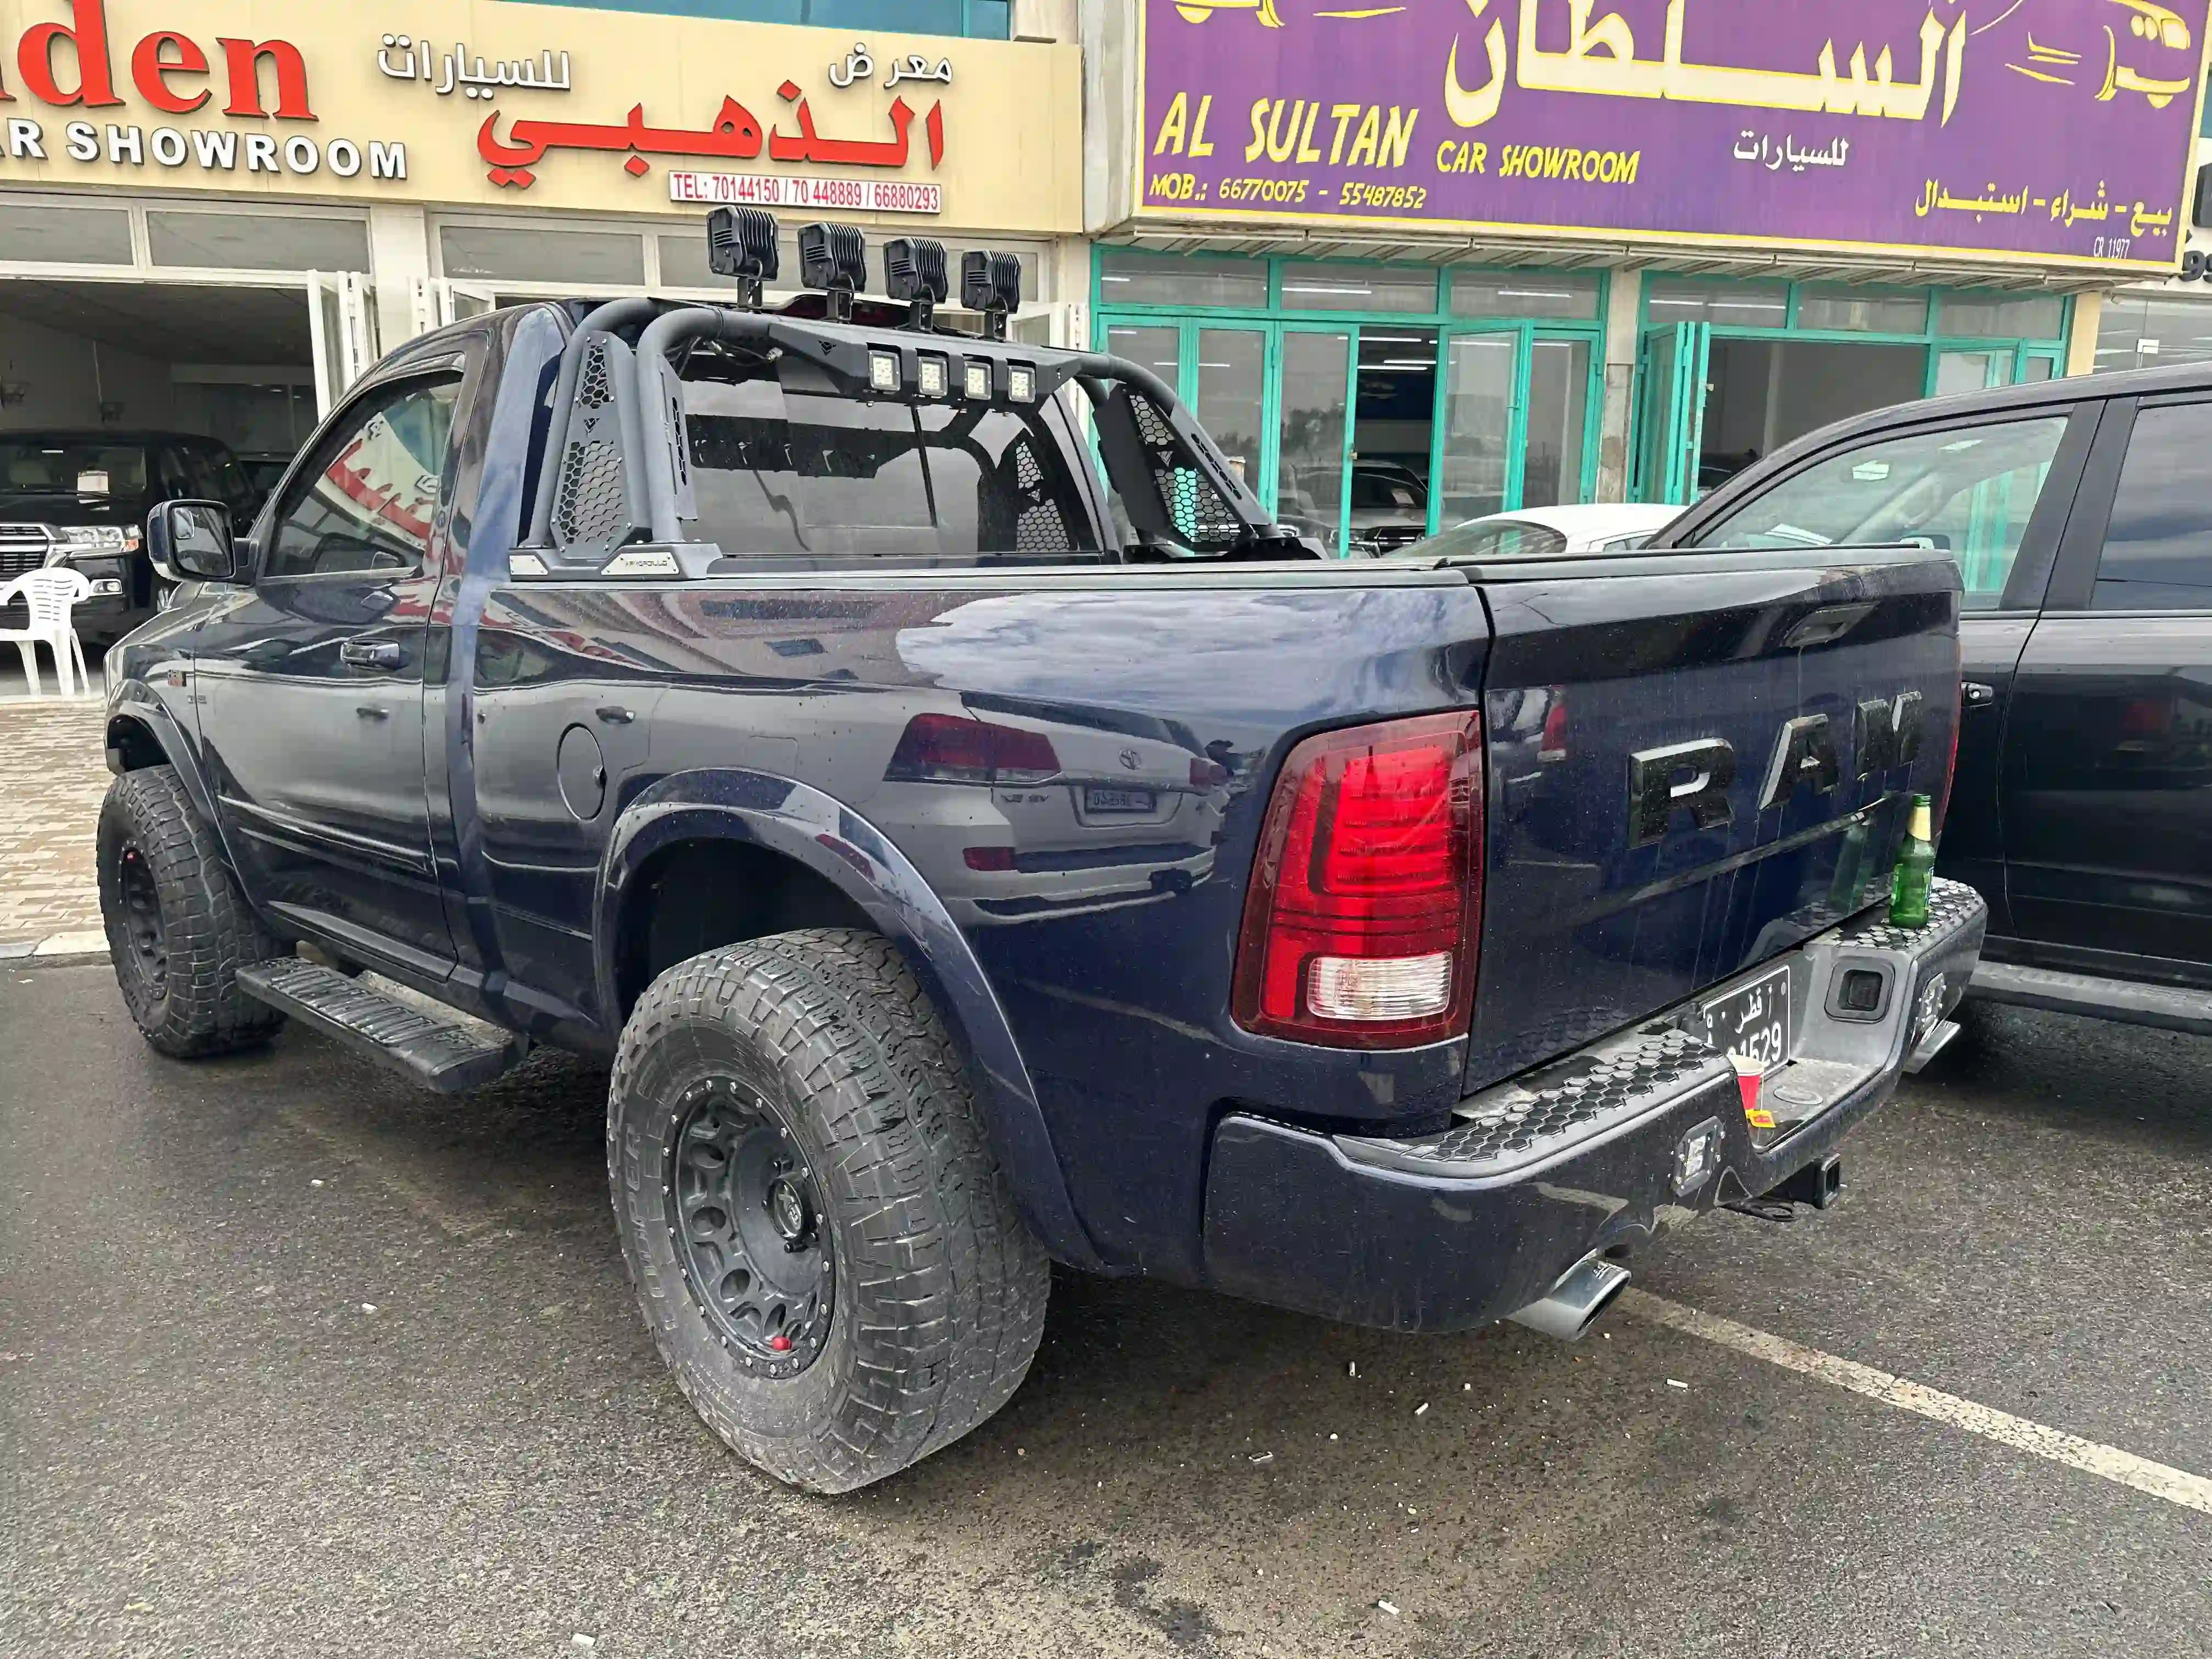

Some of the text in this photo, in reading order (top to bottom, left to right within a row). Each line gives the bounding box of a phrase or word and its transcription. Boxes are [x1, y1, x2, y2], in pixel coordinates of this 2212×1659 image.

[0, 0, 320, 121] den
[377, 33, 571, 100] للسيارات
[828, 42, 953, 89] معرض
[1444, 0, 1967, 127] السلطان
[65, 121, 408, 180] SHOWROOM
[477, 79, 944, 189] الذهبي
[1153, 92, 1420, 169] AL SULTAN
[1733, 130, 1850, 172] للسيارات
[1436, 140, 1641, 184] CAR SHOWROOM
[674, 174, 708, 199] TEL:
[712, 175, 780, 203] 70144150
[792, 180, 809, 205] 70
[813, 181, 862, 206] 448889
[874, 184, 939, 210] 66880293
[1219, 177, 1310, 203] 66770075
[1339, 182, 1427, 209] 55487852
[1915, 177, 2029, 224] استبدال
[2050, 179, 2109, 228] شراء
[2131, 201, 2172, 237] بيع
[2093, 236, 2130, 260] CR 11977
[1628, 690, 1923, 850] RAM
[1735, 986, 1762, 1035] قطر
